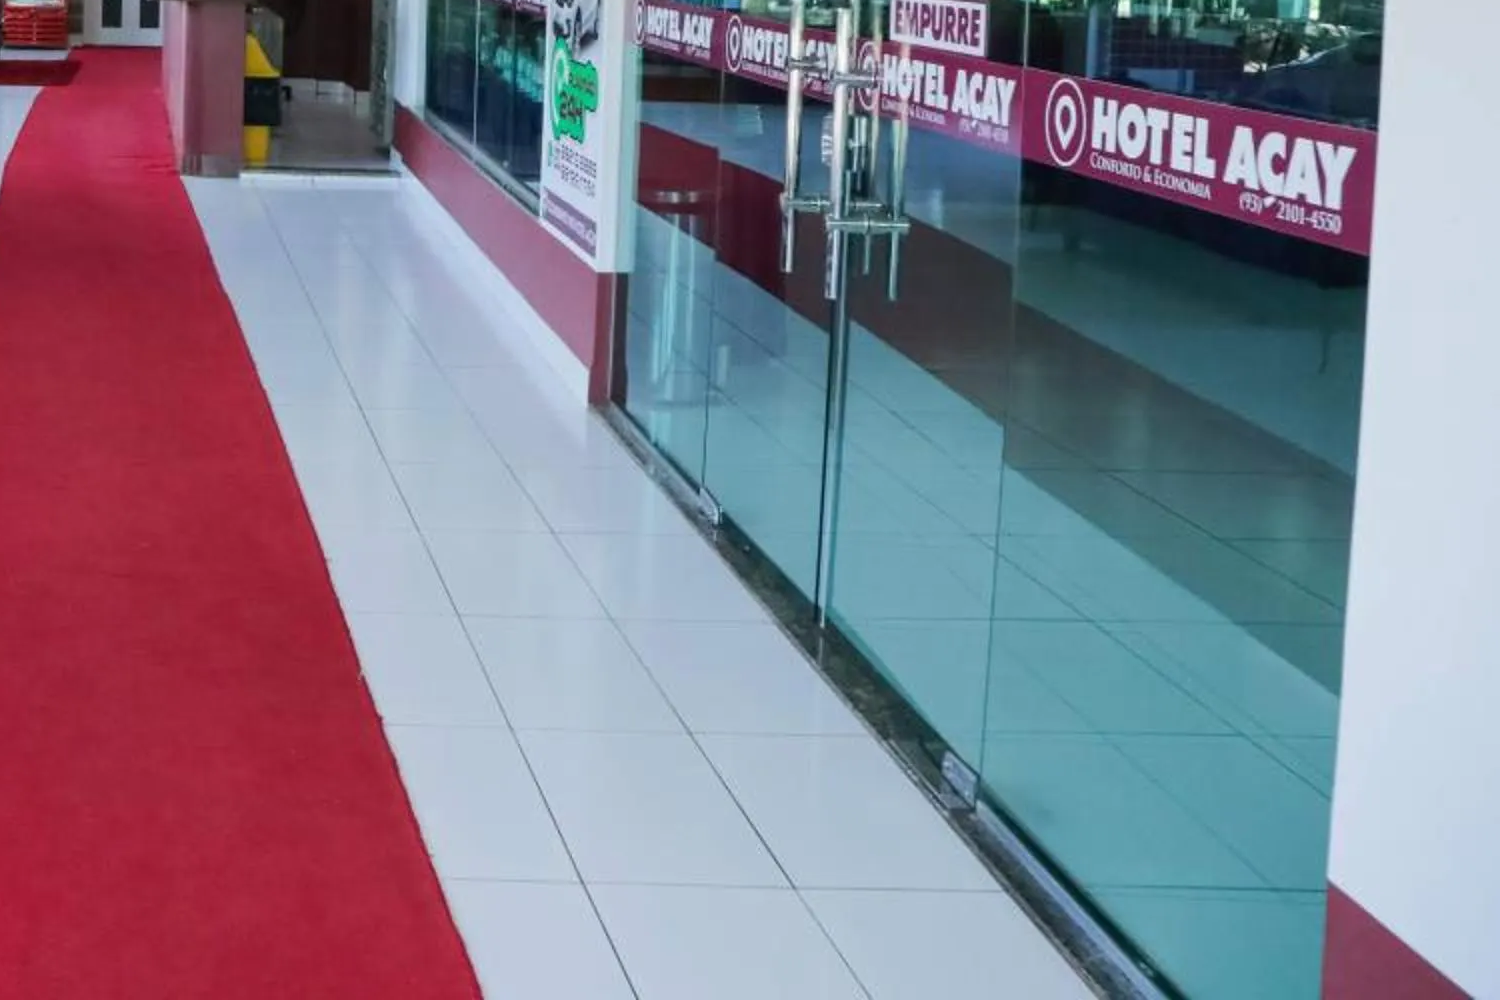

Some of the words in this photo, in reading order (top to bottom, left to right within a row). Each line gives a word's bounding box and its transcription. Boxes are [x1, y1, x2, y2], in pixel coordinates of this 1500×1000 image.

[647, 5, 680, 41] HOTEL
[894, 0, 981, 47] EMPURRE
[881, 53, 949, 110] HOTEL
[1091, 96, 1216, 179] HOTEL
